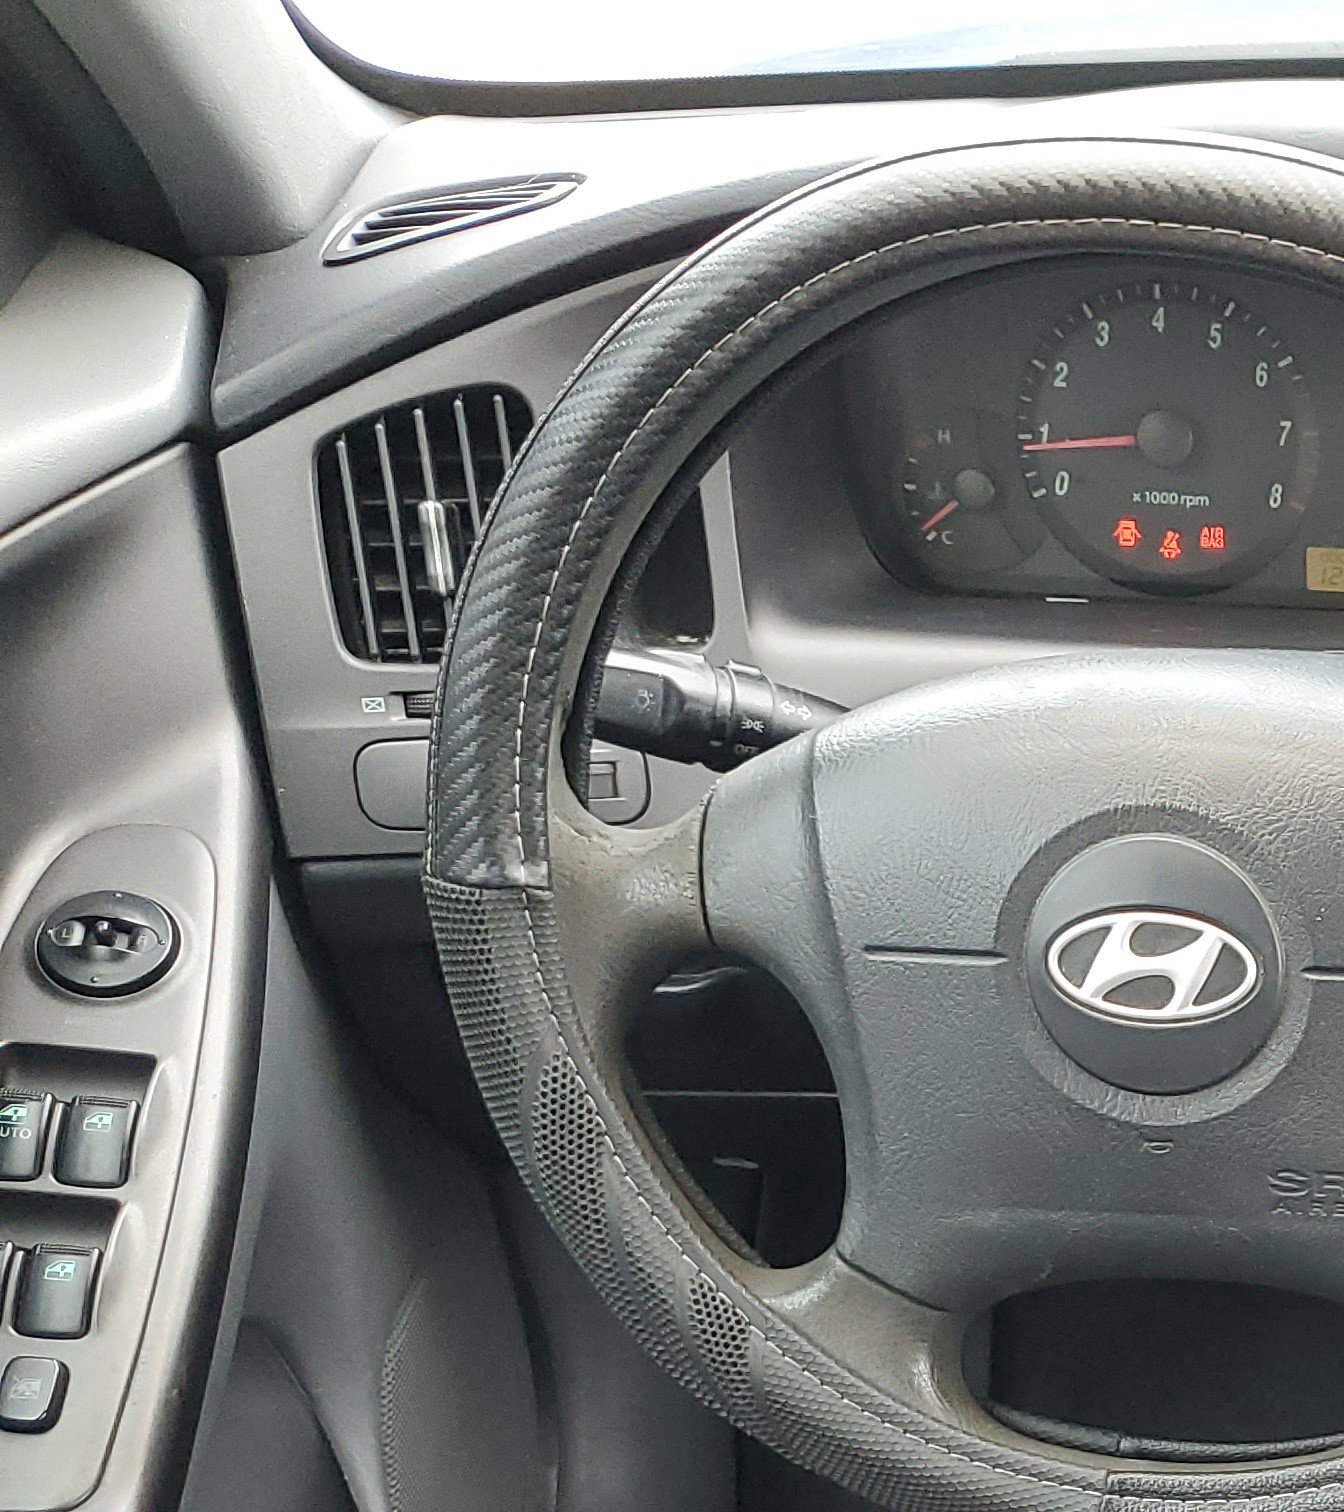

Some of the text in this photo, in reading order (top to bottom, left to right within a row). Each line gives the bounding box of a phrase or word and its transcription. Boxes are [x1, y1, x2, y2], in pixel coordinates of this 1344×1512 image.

[1151, 307, 1165, 333] 4
[1095, 320, 1110, 347] 3
[1208, 323, 1223, 348] 5
[1053, 362, 1068, 387] 2
[1255, 362, 1269, 387] 6
[937, 429, 951, 444] H
[1039, 423, 1050, 444] 1
[1279, 421, 1292, 446] 7
[1054, 470, 1070, 496] 0
[1269, 483, 1283, 508] 8
[1180, 493, 1210, 508] rpm
[941, 530, 954, 545] C
[1200, 526, 1225, 538] AIR
[0, 1125, 32, 1139] UTO
